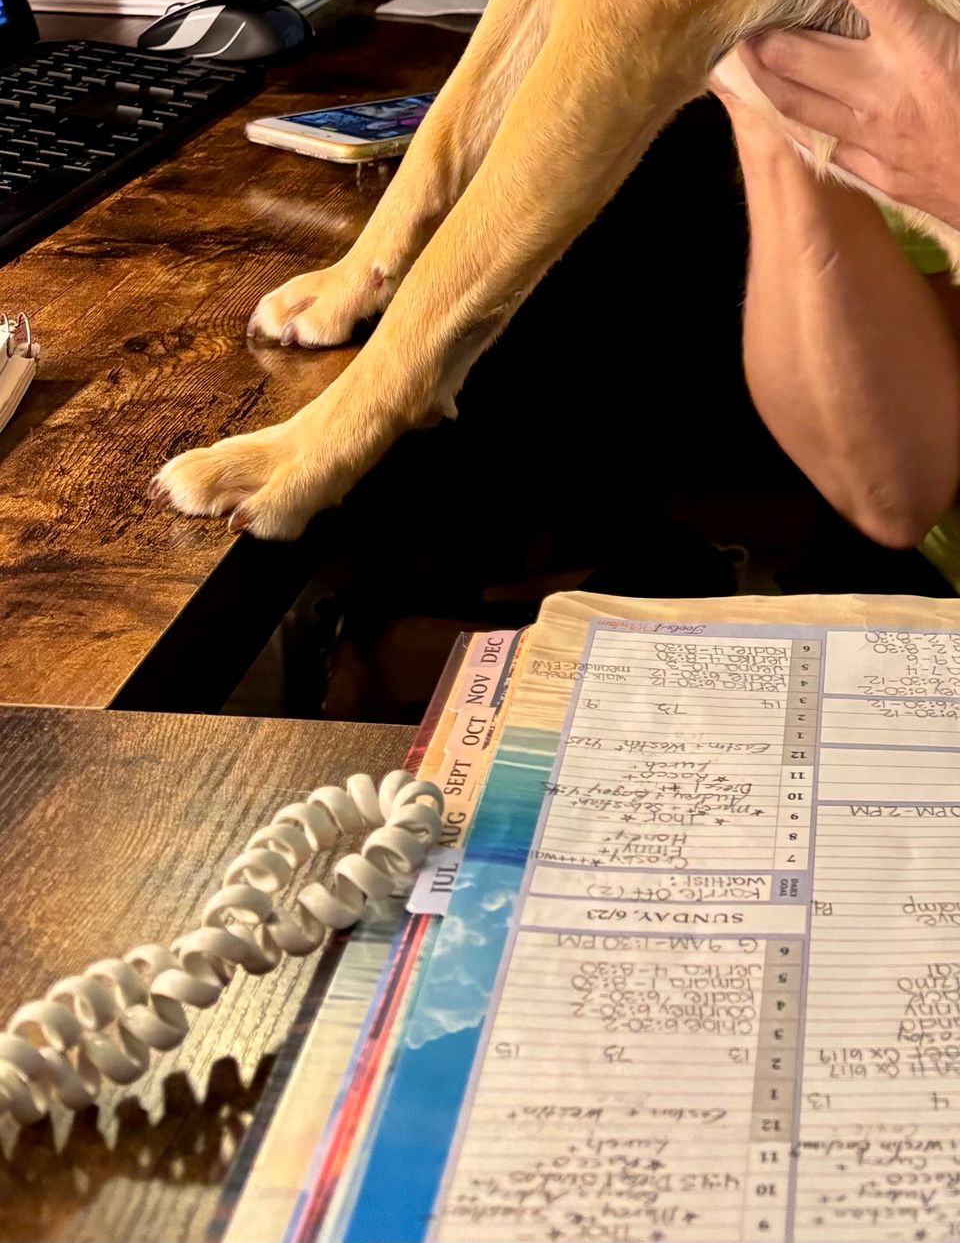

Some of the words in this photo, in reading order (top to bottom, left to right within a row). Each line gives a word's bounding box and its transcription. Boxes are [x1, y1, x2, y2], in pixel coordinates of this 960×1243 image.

[481, 637, 503, 664] DEC
[802, 663, 809, 671] 5
[465, 674, 490, 705] NOV
[462, 716, 486, 746] OCT
[791, 751, 807, 759] 12
[443, 760, 471, 796] SEPT
[787, 792, 804, 800] 10
[437, 811, 466, 849] AUG
[787, 854, 796, 862] 7
[780, 878, 788, 897] GOAL
[790, 877, 798, 898] DAILY
[680, 888, 760, 900] Karrie
[587, 910, 627, 921] 6/23
[634, 910, 744, 923] SUNDAY,
[737, 937, 758, 952] G
[780, 947, 789, 955] 6
[669, 977, 753, 990] Tamara
[779, 974, 787, 983] 5
[660, 998, 758, 1017] Courtney
[777, 1001, 785, 1011] 4
[774, 1028, 783, 1039] 3
[772, 1058, 780, 1069] 2
[771, 1089, 778, 1099] 1
[931, 1092, 950, 1111] 4
[762, 1119, 781, 1131] 12
[760, 1152, 779, 1164] 11
[756, 1184, 777, 1195] 10
[758, 1221, 770, 1232] 9
